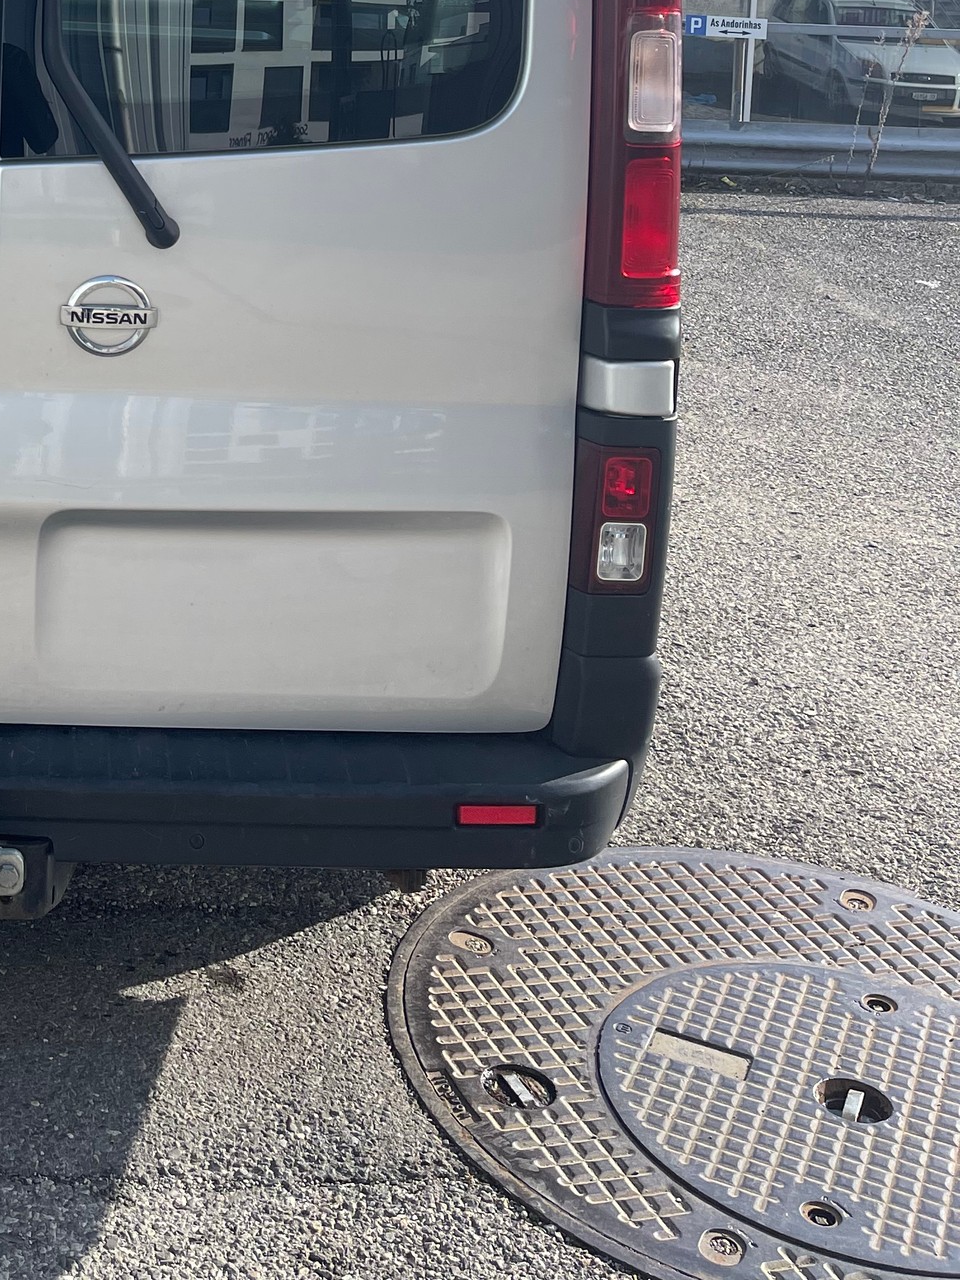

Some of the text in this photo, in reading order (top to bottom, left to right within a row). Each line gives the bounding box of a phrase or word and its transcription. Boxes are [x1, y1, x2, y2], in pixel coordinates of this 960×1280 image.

[690, 17, 702, 34] P
[710, 18, 762, 30] As Andorinhas
[70, 311, 147, 325] NISSAN
